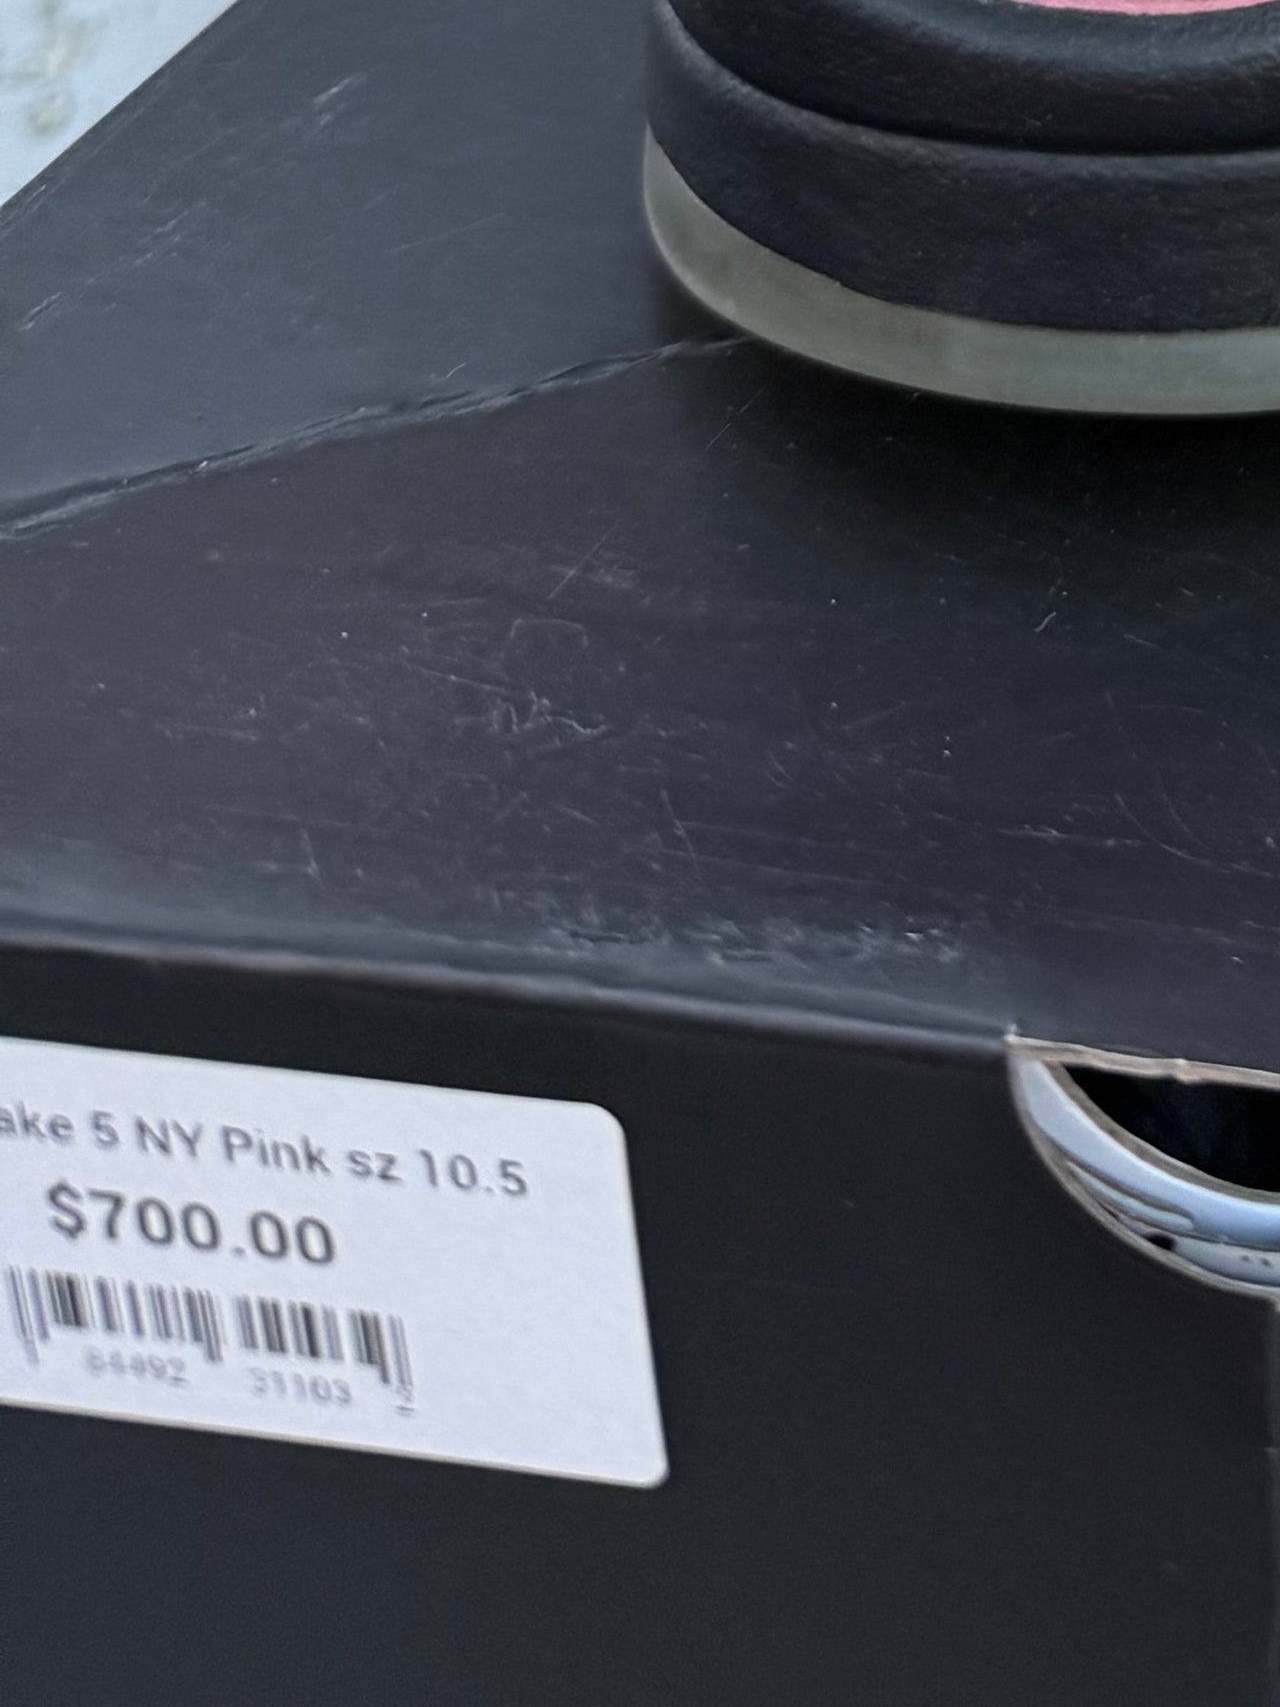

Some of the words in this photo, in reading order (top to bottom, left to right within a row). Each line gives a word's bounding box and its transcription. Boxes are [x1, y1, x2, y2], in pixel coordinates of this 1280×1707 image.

[90, 1109, 120, 1150] 5
[133, 1115, 204, 1159] NY
[220, 1124, 331, 1177] Pink
[346, 1148, 404, 1184] sz
[416, 1147, 529, 1197] 10.5
[47, 1178, 337, 1265] $700.00
